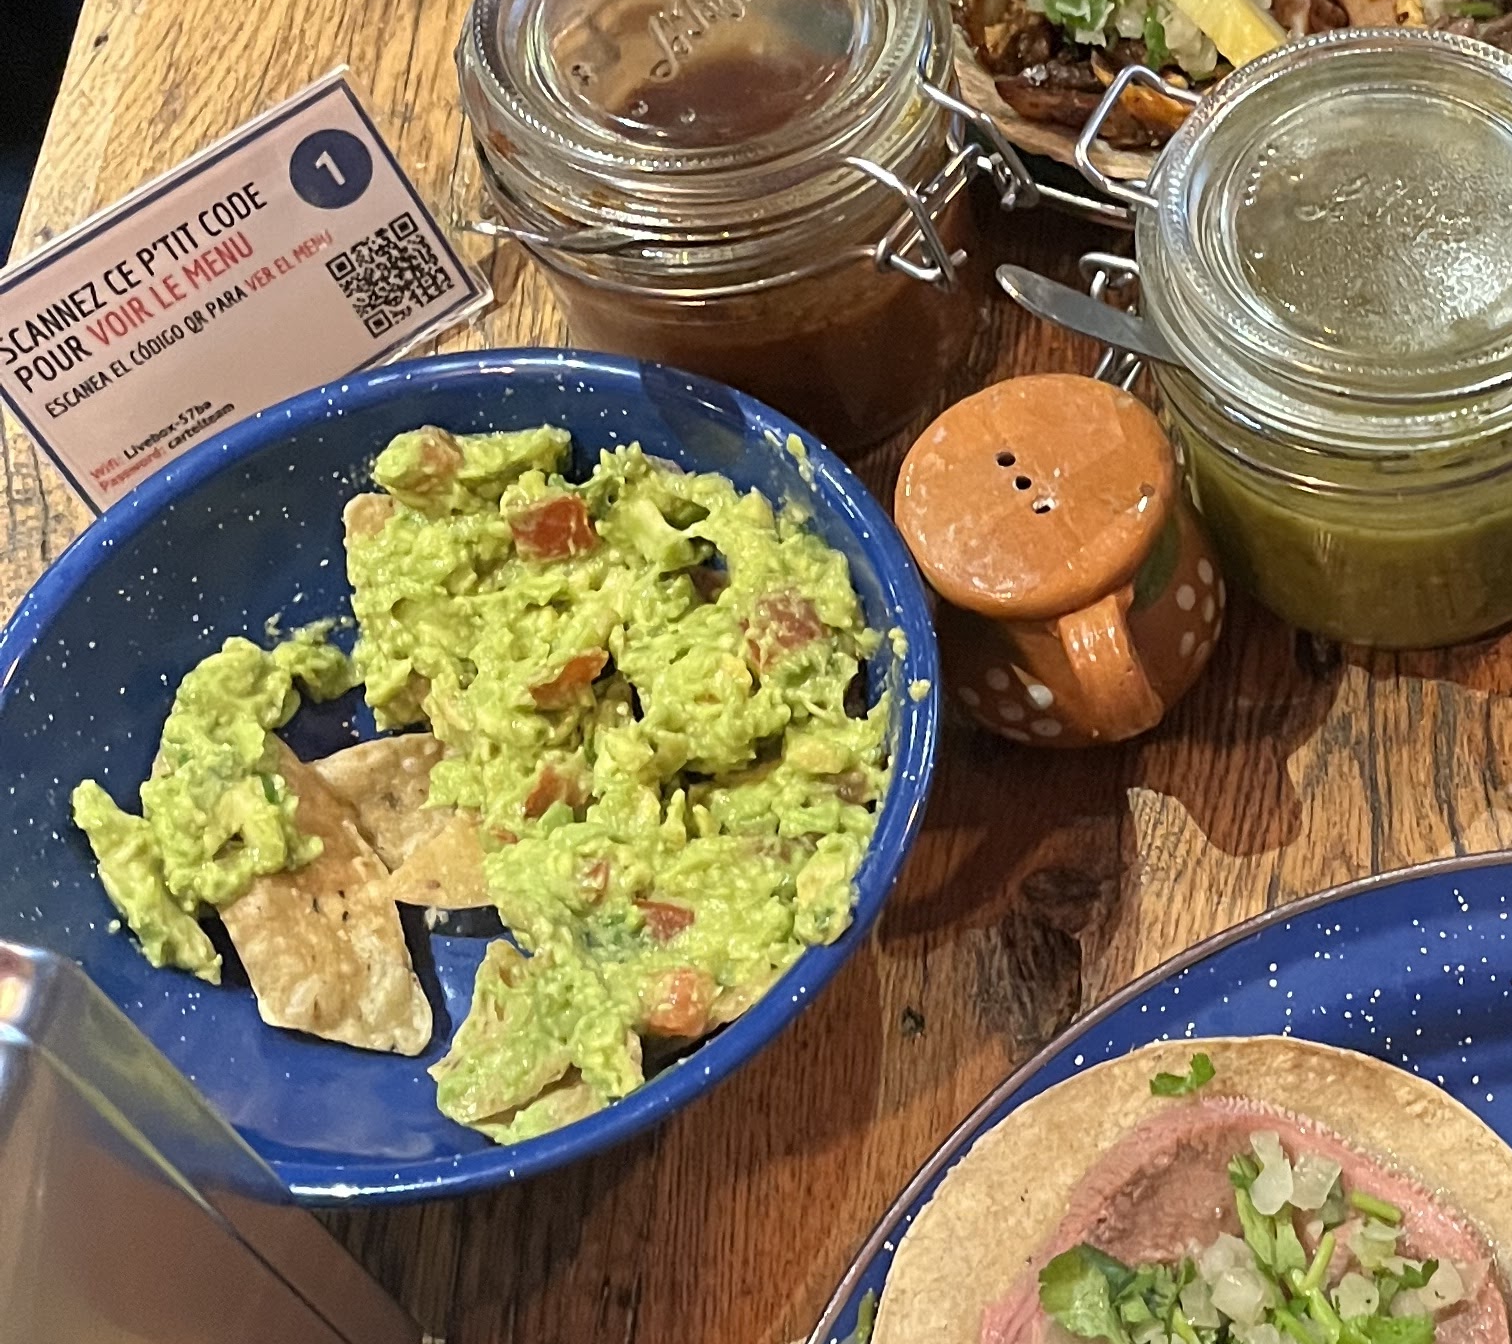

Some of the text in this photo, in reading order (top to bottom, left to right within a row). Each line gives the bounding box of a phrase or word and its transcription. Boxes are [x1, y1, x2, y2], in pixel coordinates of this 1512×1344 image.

[315, 150, 346, 186] 1
[0, 181, 268, 366] SCANNEZ CE P'TIT CODE
[14, 231, 254, 394] POUR VOIR LE MENU
[45, 371, 114, 419] ESCANEA
[109, 359, 133, 378] EL
[183, 310, 209, 334] QR
[205, 285, 249, 319] PARA
[245, 266, 277, 292] VER
[273, 256, 297, 275] EL
